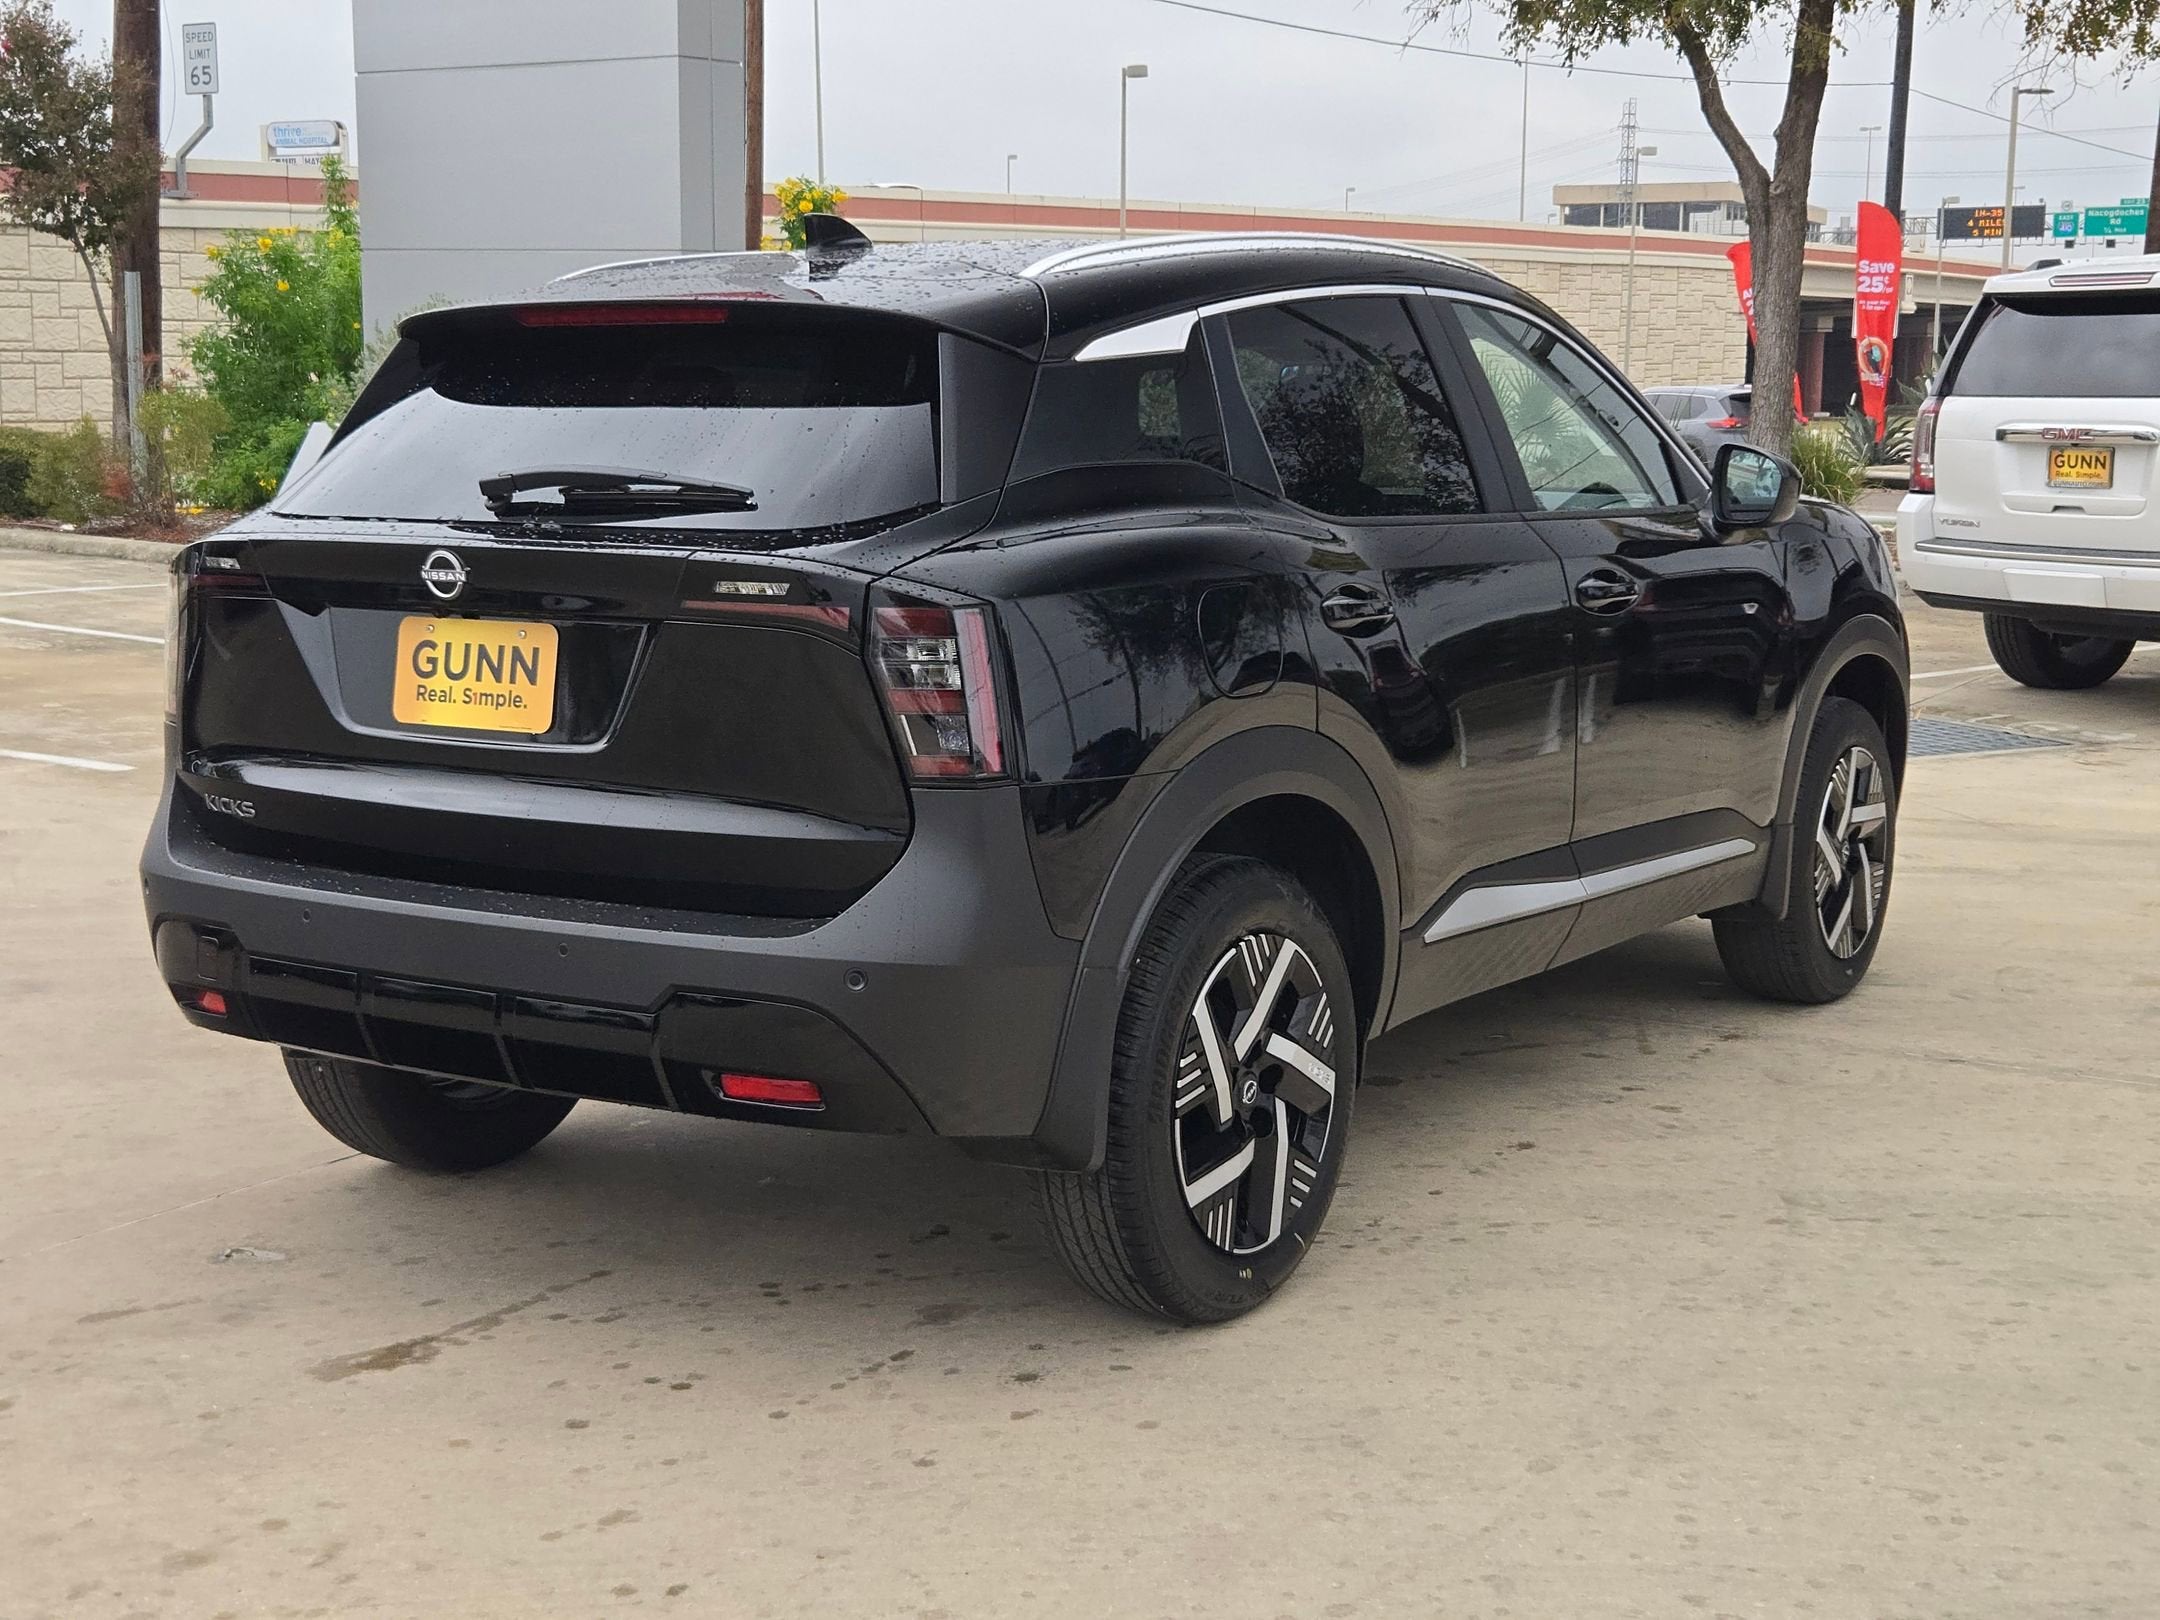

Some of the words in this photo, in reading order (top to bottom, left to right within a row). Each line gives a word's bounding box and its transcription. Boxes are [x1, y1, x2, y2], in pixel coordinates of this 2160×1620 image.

[185, 31, 214, 43] SPEED
[189, 48, 210, 60] LIMIT
[190, 65, 212, 86] 65
[273, 126, 302, 138] thrive
[2088, 208, 2145, 218] Nacogdoches
[2110, 217, 2122, 225] Rd
[1984, 228, 2002, 236] MIN
[1858, 259, 1896, 274] Save
[2041, 427, 2095, 441] GMC
[2054, 453, 2107, 470] GUNN
[421, 570, 466, 582] NISSAN
[412, 639, 540, 687] GUNN
[416, 684, 457, 704] Real.
[204, 793, 256, 818] KICKS
